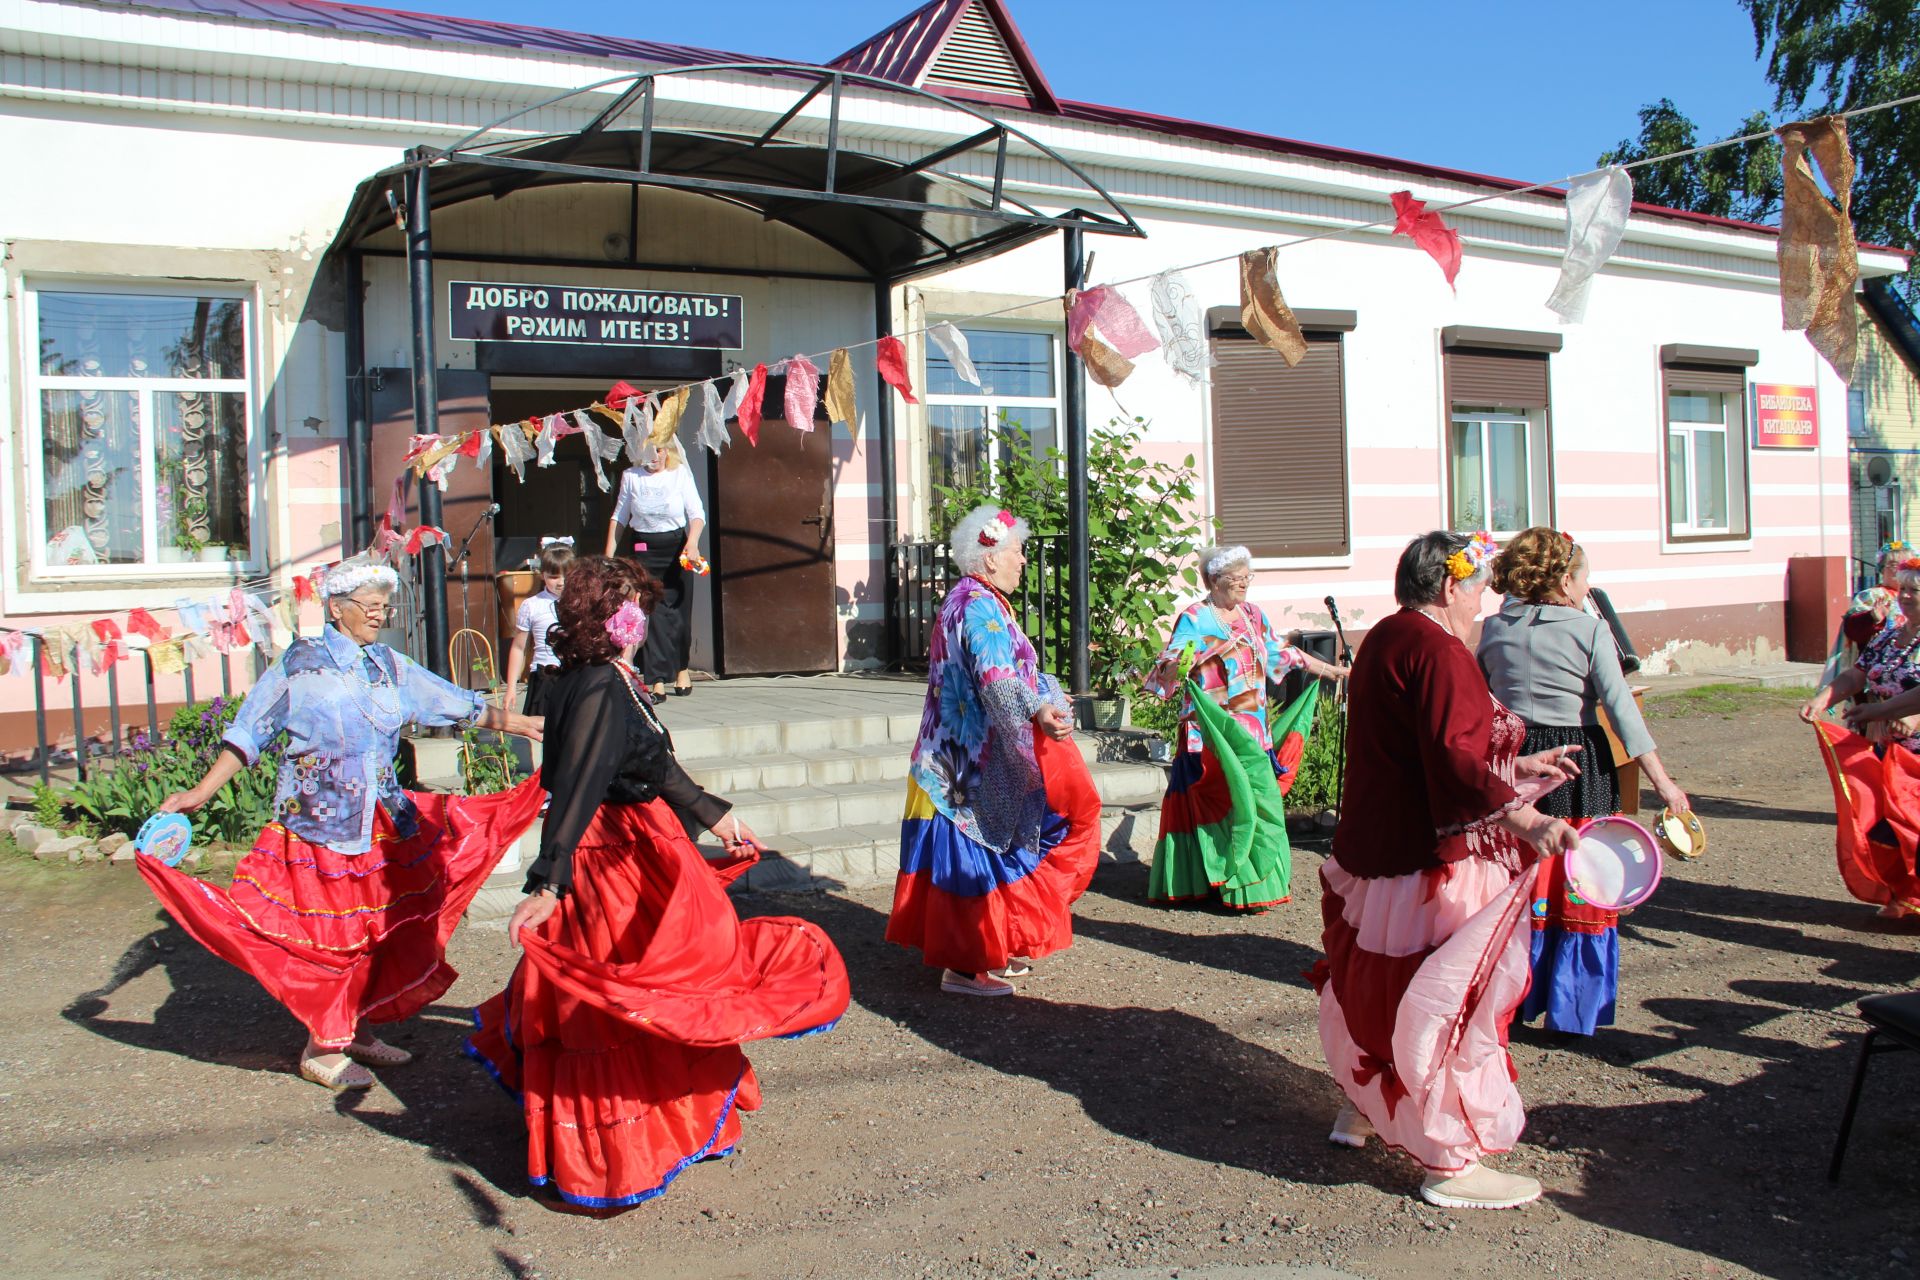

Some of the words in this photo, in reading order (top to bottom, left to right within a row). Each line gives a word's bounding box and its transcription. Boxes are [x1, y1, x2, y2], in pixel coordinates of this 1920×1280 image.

[466, 287, 549, 310] ДОБРО
[562, 291, 729, 318] ПОЖАЛОВАТЬ!
[506, 316, 587, 338] РӘХИМ
[600, 320, 690, 341] ИТЕГЕЗ!
[1760, 395, 1813, 411] БИБЛИОТЕКА
